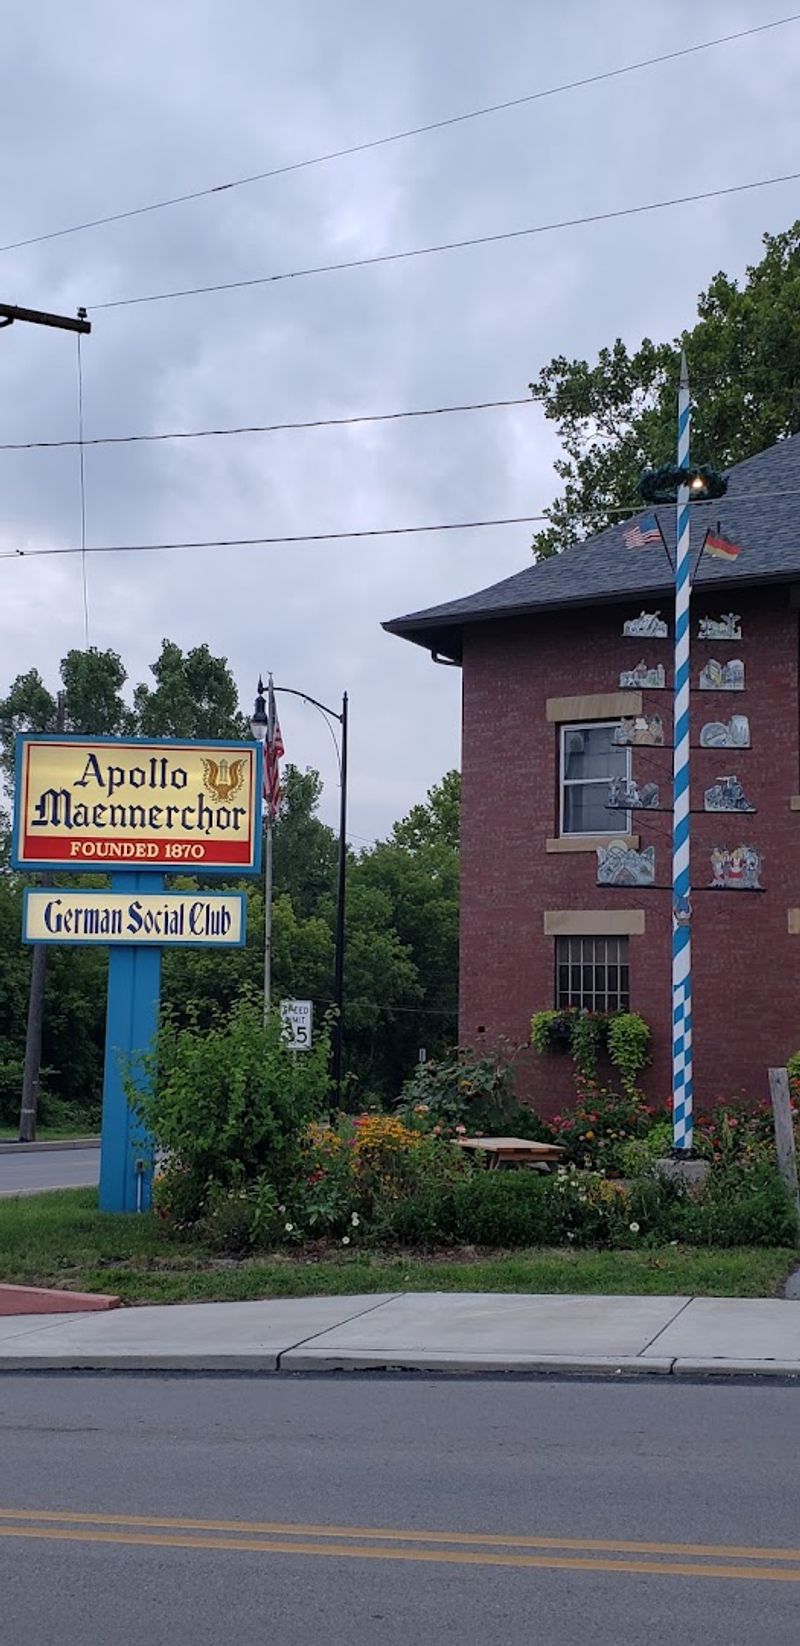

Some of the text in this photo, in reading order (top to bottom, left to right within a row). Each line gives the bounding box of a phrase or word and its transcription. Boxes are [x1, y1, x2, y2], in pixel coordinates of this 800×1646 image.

[73, 753, 188, 798] Apollo
[31, 787, 247, 835] Maennerchor
[70, 841, 205, 858] FOUNDED 1870
[44, 899, 231, 936] German Social Club
